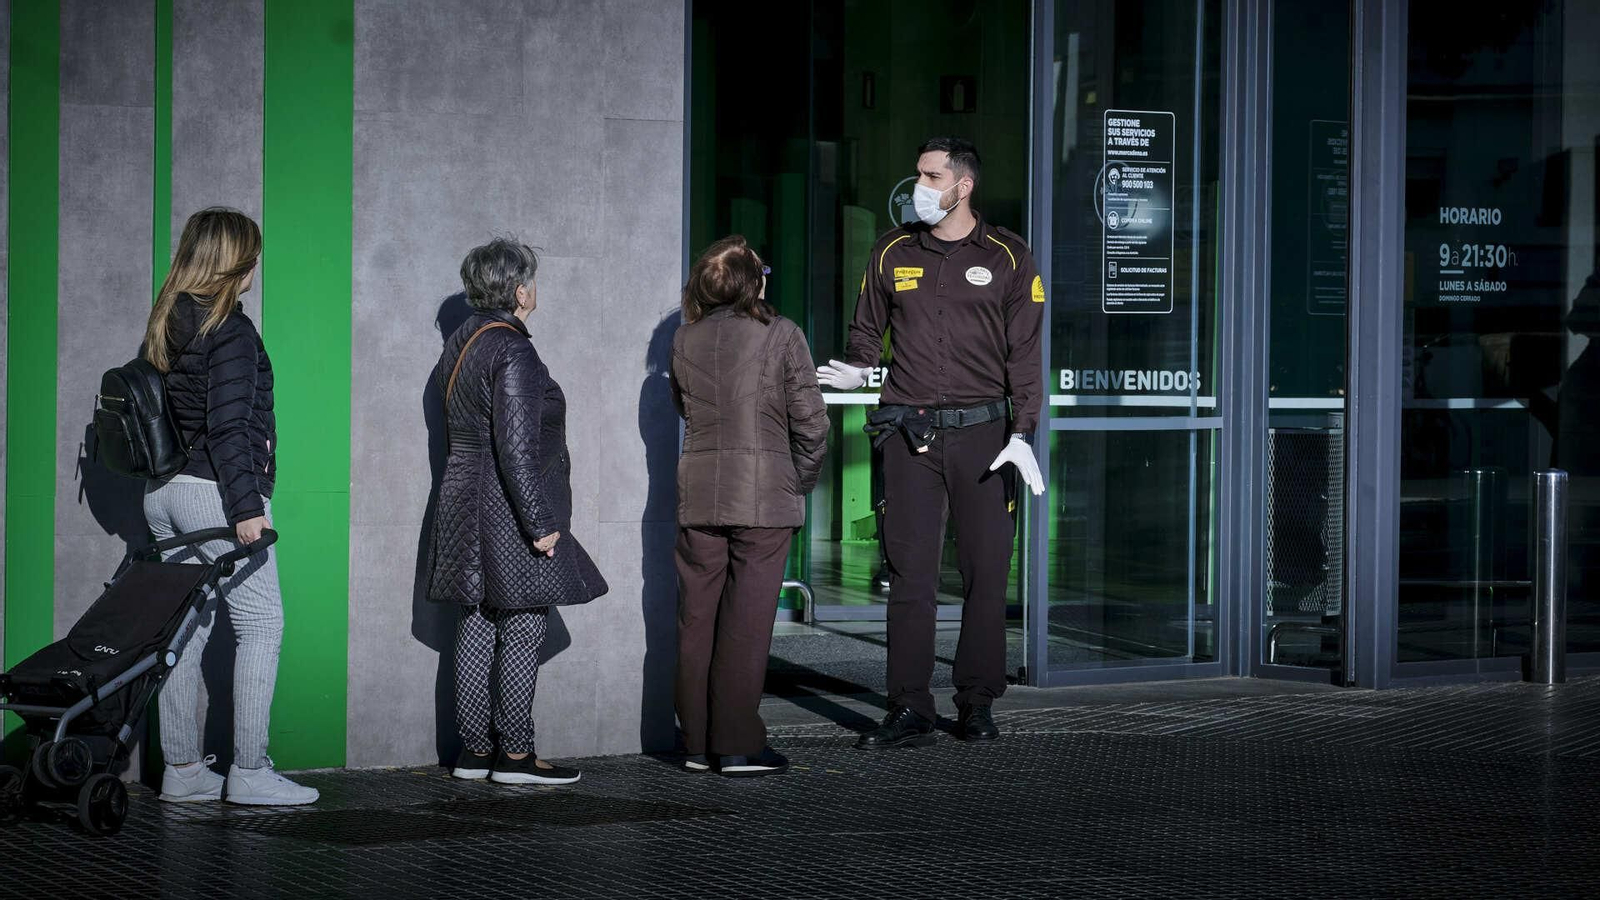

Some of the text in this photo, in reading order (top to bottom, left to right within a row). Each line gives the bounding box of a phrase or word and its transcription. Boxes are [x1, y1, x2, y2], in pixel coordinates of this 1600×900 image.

[1108, 118, 1140, 127] GESTIONE
[1108, 128, 1155, 137] SUS SERVICIOS
[1108, 137, 1113, 145] A
[1115, 136, 1139, 146] TRAVÉS
[1440, 207, 1501, 225] HORARIO
[1440, 244, 1450, 267] 9
[1440, 279, 1506, 291] LUNES A SÁBADO
[1060, 369, 1201, 391] BIENVENIDOS
